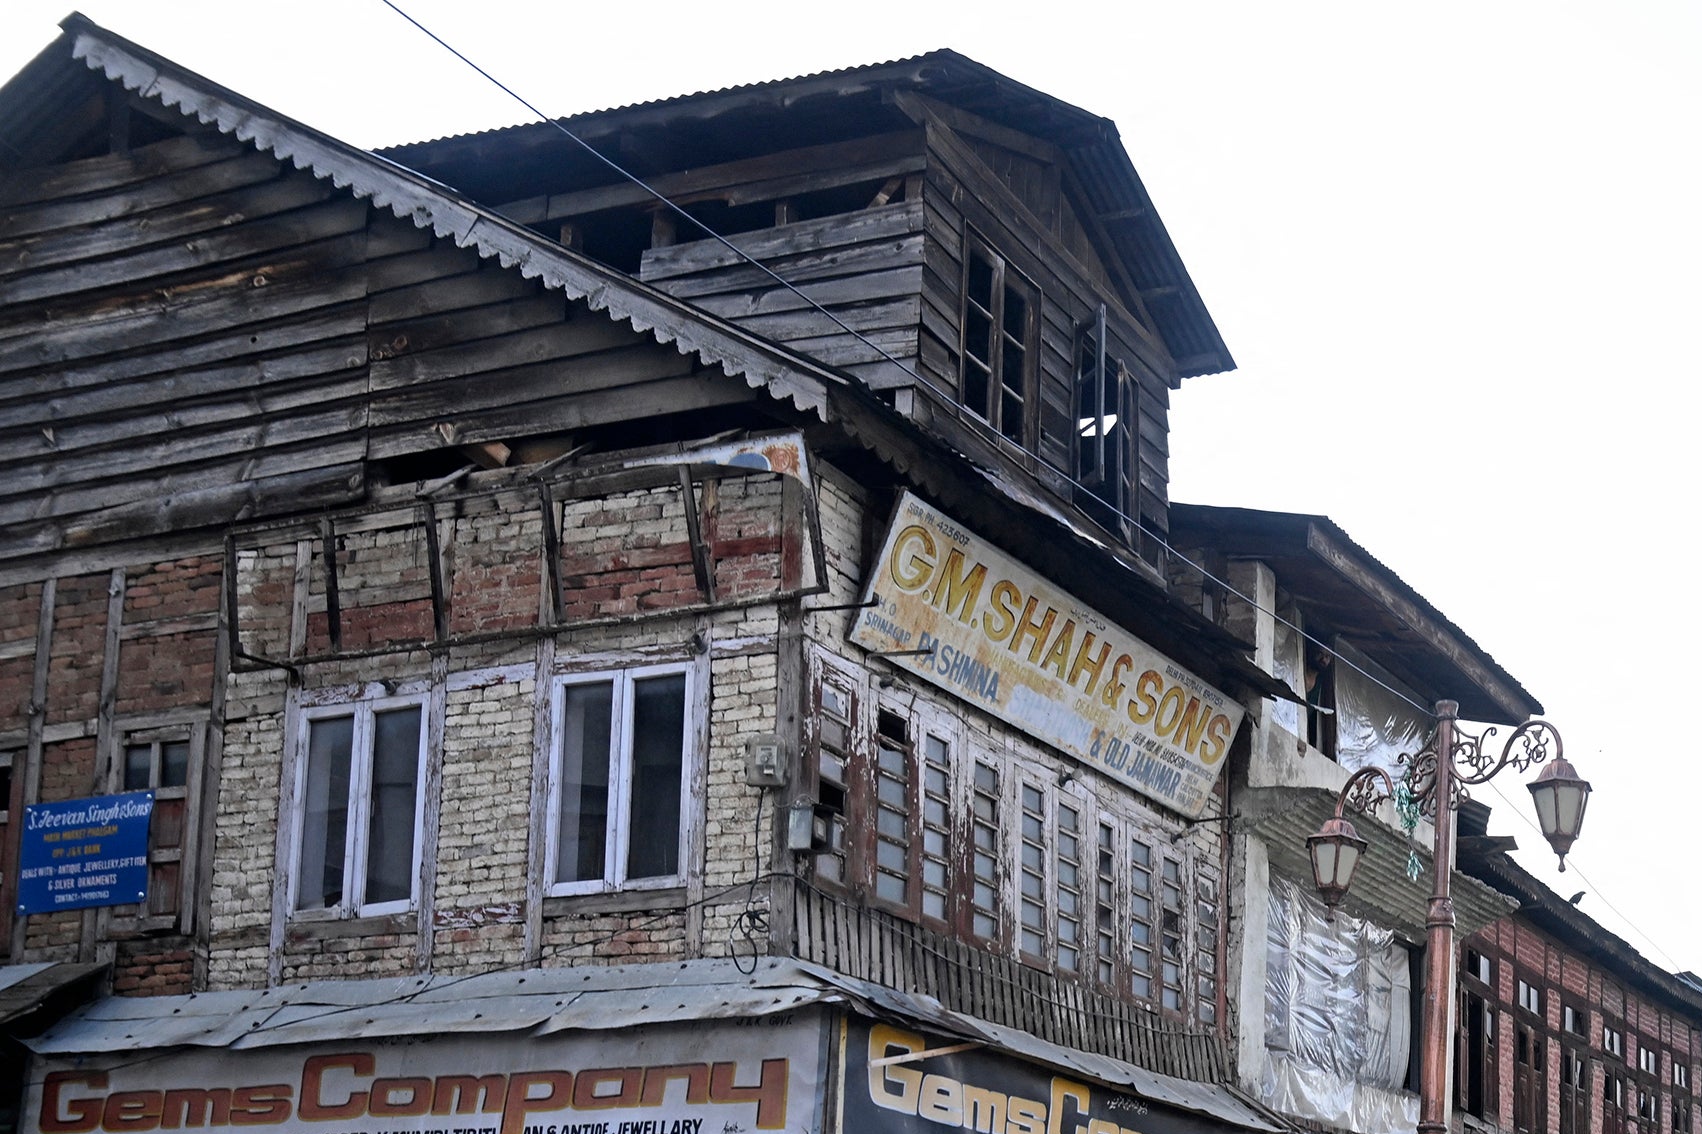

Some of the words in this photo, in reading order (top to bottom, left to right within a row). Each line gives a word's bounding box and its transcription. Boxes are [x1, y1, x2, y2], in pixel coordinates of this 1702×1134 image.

[914, 630, 999, 702] PASHMINA
[1101, 653, 1134, 710] &
[1128, 669, 1232, 765] SONS
[1104, 736, 1130, 770] OLD
[1126, 751, 1182, 799] JAMAWAR
[54, 879, 75, 890] SILVER
[77, 874, 117, 888] ORNAMENTS
